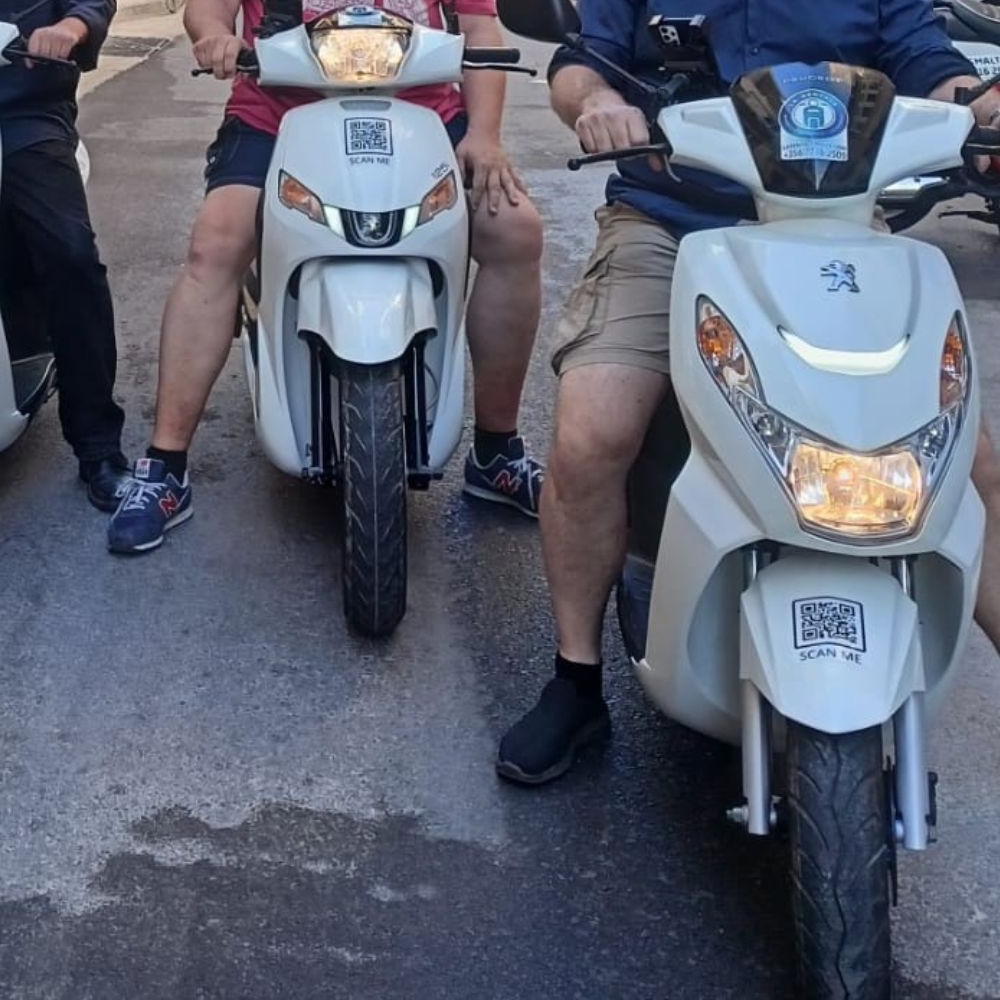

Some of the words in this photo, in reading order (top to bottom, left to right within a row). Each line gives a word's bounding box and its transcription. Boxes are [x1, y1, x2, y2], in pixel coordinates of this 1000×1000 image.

[350, 157, 374, 165] SCAN
[800, 648, 836, 662] SCAN
[841, 651, 862, 665] ME
